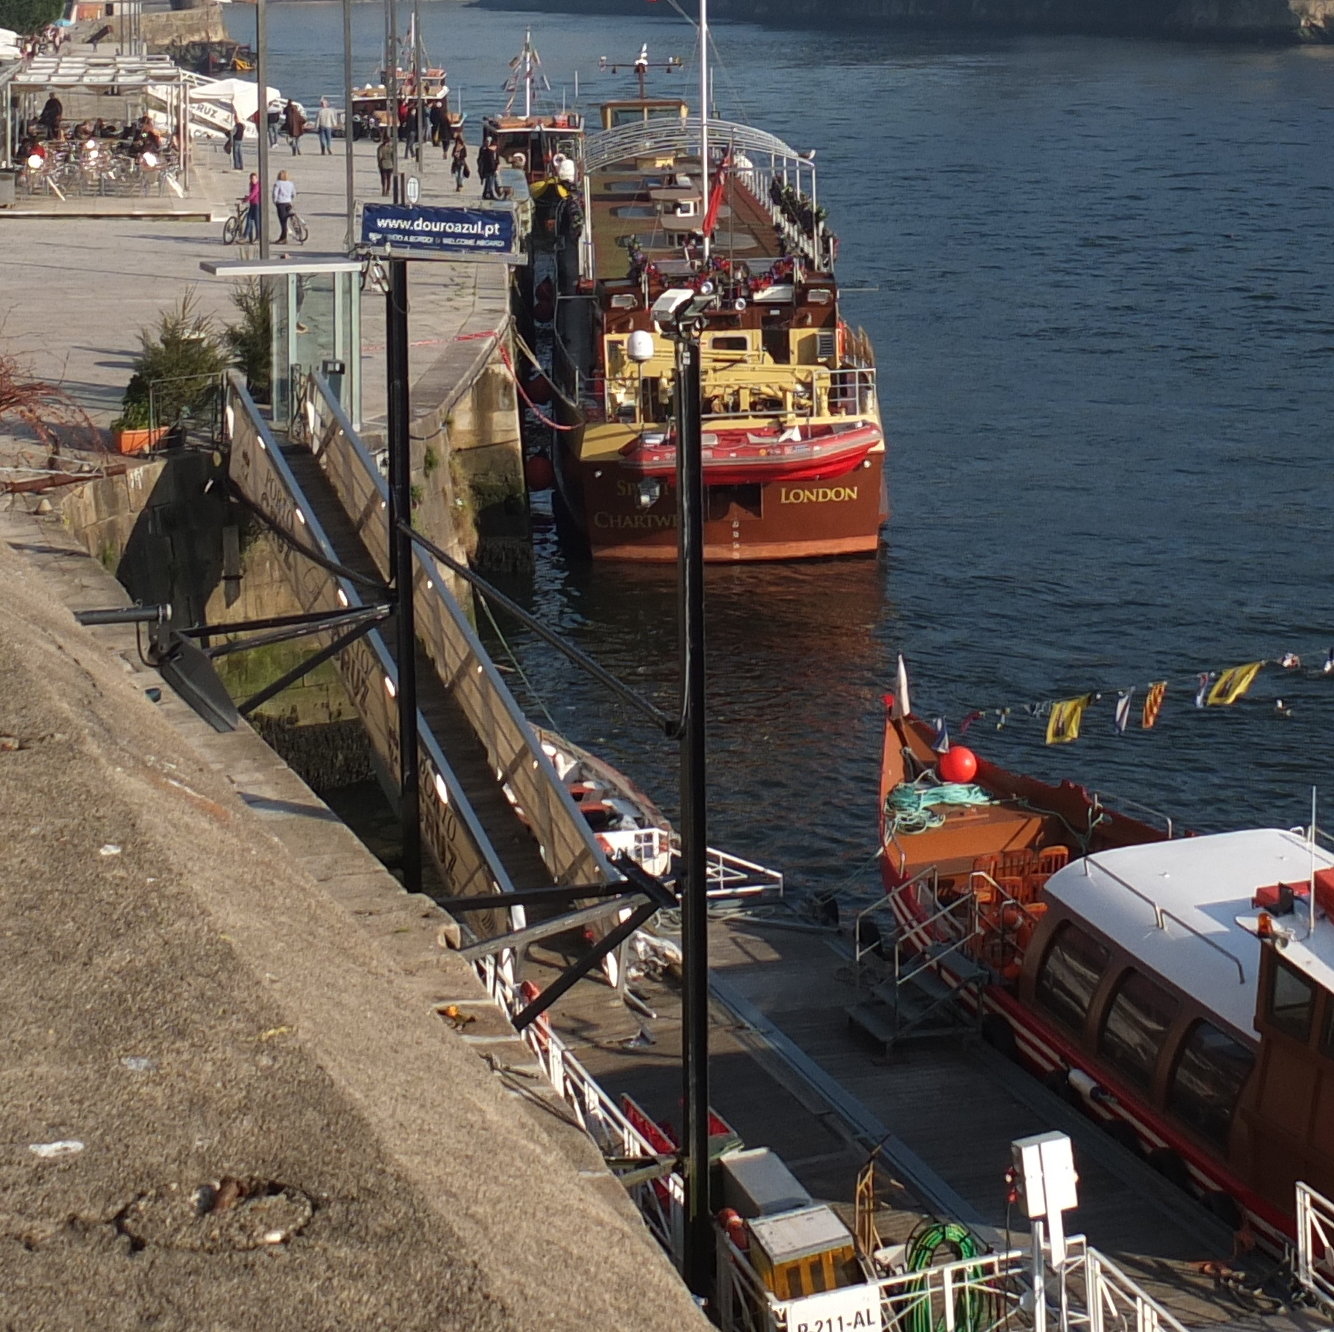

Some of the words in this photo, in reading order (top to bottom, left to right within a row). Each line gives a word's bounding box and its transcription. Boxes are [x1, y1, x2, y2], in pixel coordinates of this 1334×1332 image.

[376, 217, 501, 238] www.douroazul.pt
[616, 479, 670, 497] SPT
[780, 485, 859, 505] LONDON
